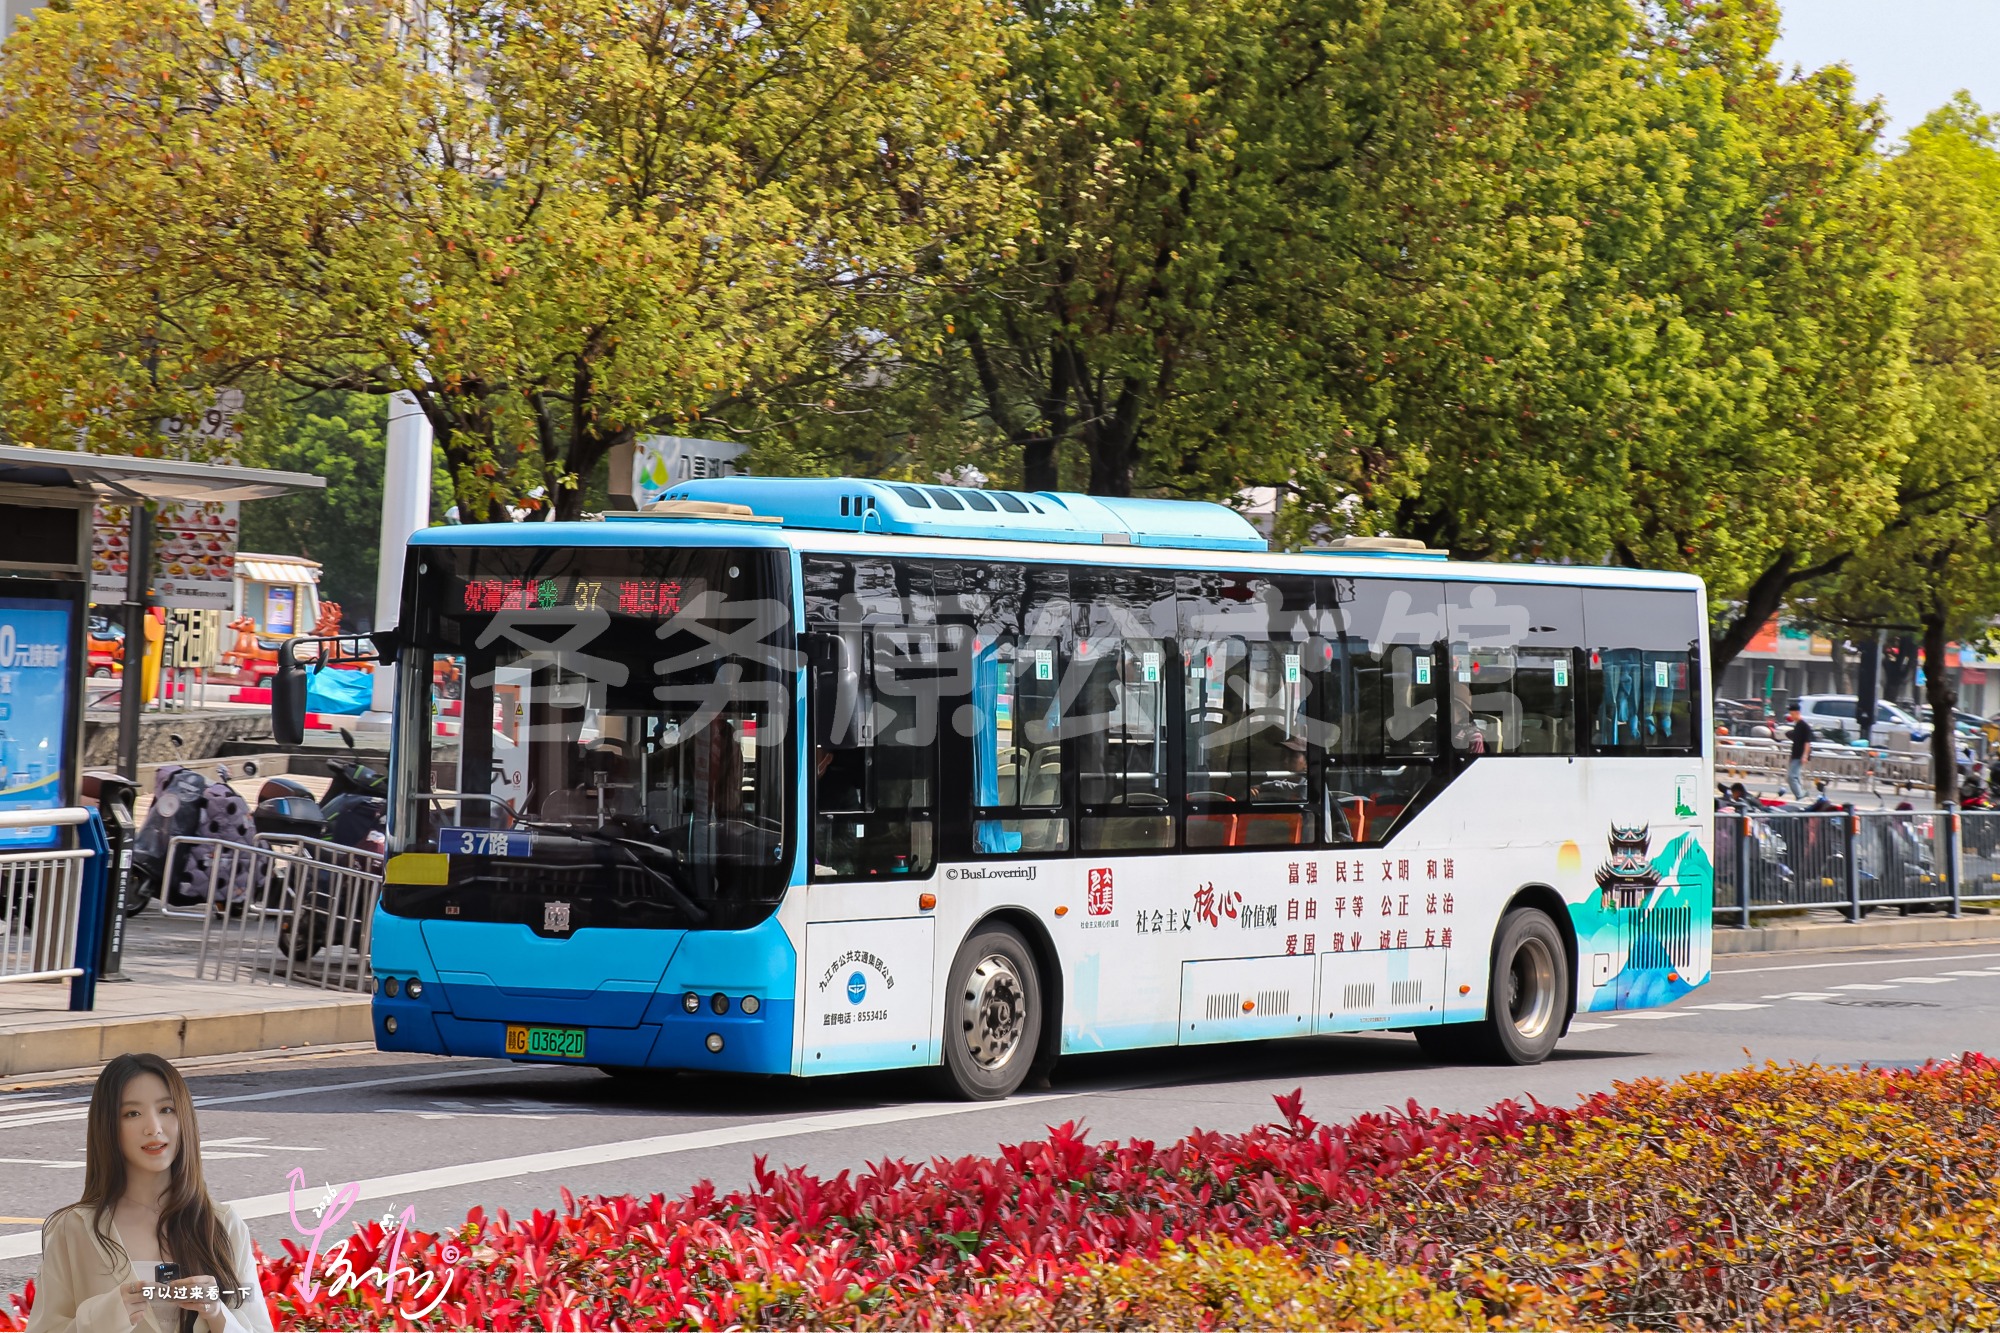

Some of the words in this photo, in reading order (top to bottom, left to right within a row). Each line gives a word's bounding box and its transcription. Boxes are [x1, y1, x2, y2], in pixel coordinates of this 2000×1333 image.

[574, 582, 602, 612] 37
[460, 832, 509, 857] 37路
[1288, 861, 1318, 885] 富强
[1335, 860, 1364, 883] 民主
[1382, 859, 1410, 882] 文明
[1426, 858, 1454, 881] 和谐
[1136, 881, 1277, 934] 社会主义核心价值观
[1287, 897, 1317, 921] 自由
[1334, 895, 1364, 918] 平等
[1381, 894, 1410, 916] 公正
[1426, 892, 1454, 915] 法治
[1286, 933, 1316, 956] 爱国
[1333, 931, 1362, 952] 敬业
[1379, 929, 1408, 950] 诚信
[1424, 927, 1453, 949] 友善
[818, 950, 895, 993] 九江市公共交通集团公司
[531, 1031, 583, 1054] 03622D
